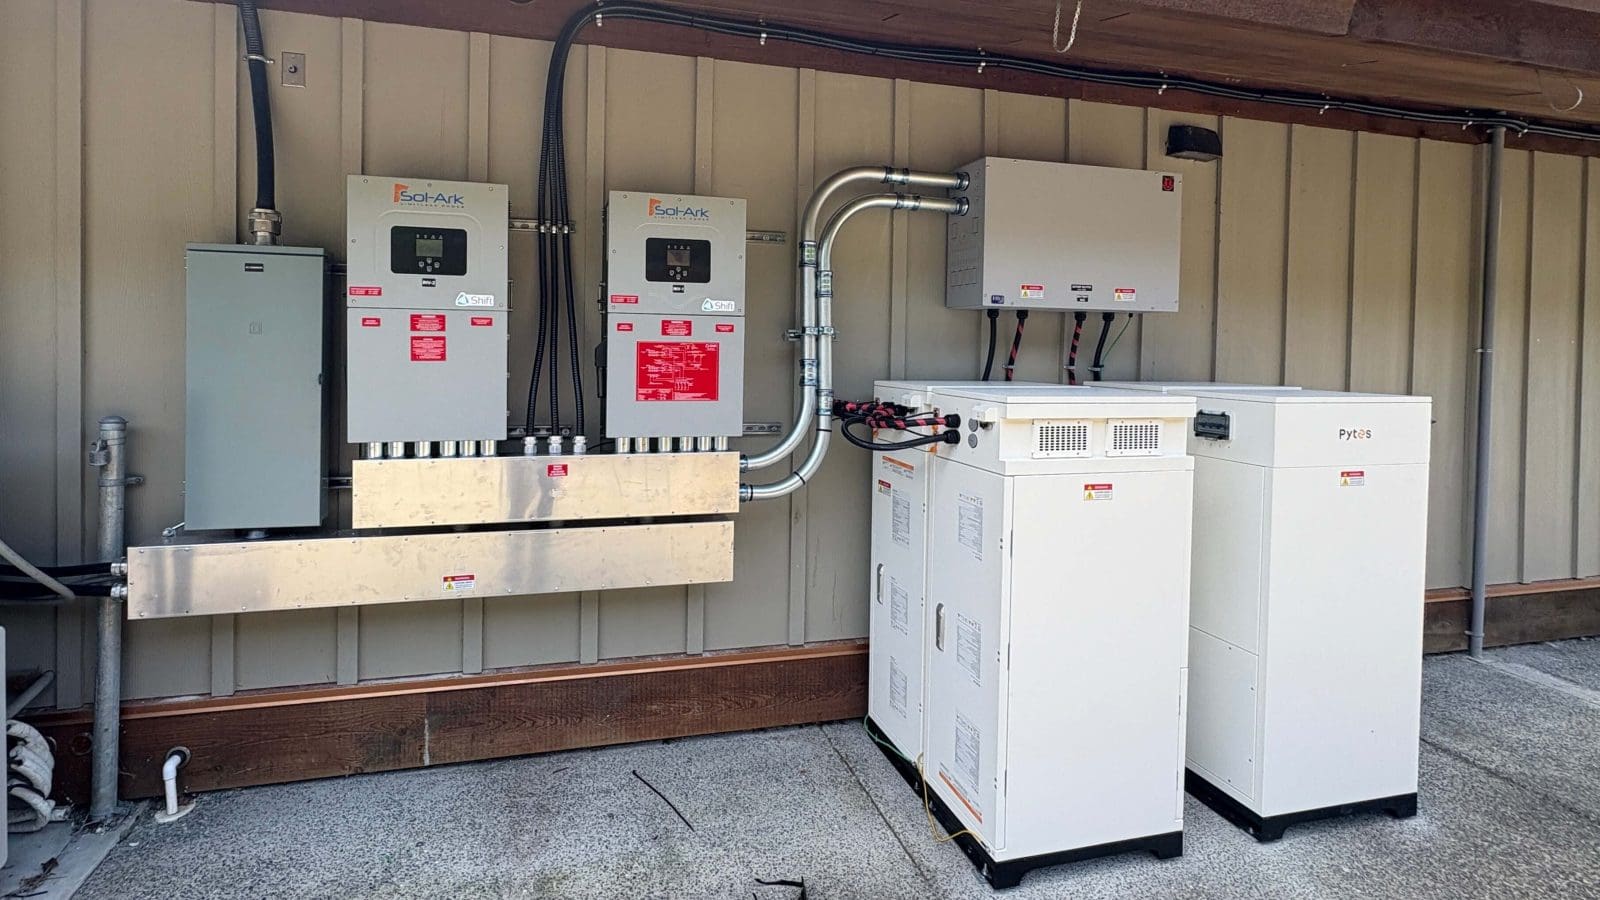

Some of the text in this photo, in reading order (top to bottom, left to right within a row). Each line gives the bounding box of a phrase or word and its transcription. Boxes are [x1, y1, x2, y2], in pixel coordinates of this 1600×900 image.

[400, 191, 464, 205] Sol-Ark
[655, 205, 709, 218] Sol-Ark
[471, 295, 492, 304] Shift
[714, 301, 733, 310] Shift
[1339, 429, 1371, 440] Pytes
